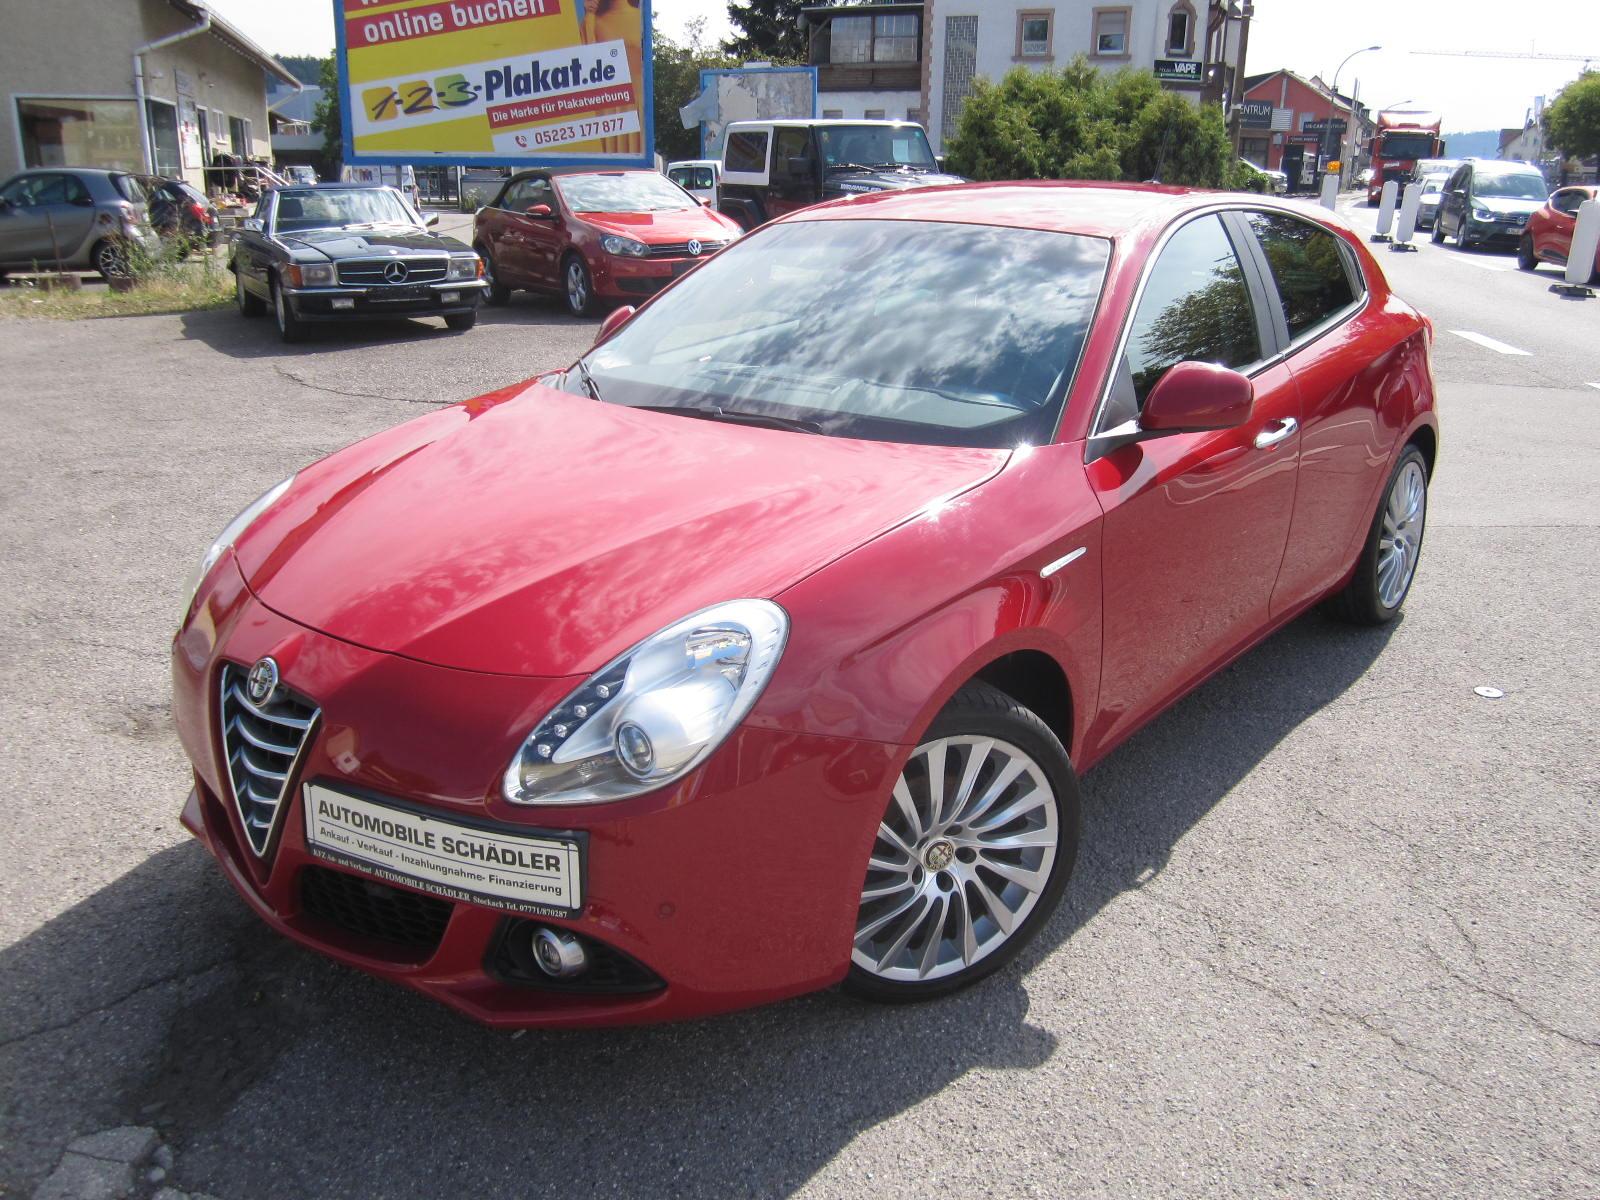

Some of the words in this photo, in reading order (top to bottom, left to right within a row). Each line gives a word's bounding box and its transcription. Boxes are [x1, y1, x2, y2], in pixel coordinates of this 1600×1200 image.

[364, 11, 444, 43] online
[451, 0, 545, 27] buchen
[1174, 62, 1197, 74] VAPE
[492, 112, 508, 122] Die
[510, 106, 539, 119] Marke
[541, 102, 556, 114] für
[557, 91, 630, 111] Plakatwerbung
[1240, 104, 1271, 116] ENTRUM
[534, 126, 576, 145] 05223
[579, 122, 600, 137] 177
[602, 118, 624, 133] 877
[318, 799, 436, 850] AUTOMOBILE
[441, 836, 561, 872] SCHÄDLER
[320, 827, 350, 845] Ankauf
[356, 839, 393, 858] Verkauf
[401, 852, 485, 881] Inzahlungnahme-
[488, 874, 562, 896] Finanzierung
[374, 868, 425, 890] AUTOMOBILE
[426, 882, 471, 902] SCHÄDLER
[473, 895, 504, 909] Stockach
[506, 902, 518, 911] Tel.
[519, 904, 568, 918] 07771/870287
